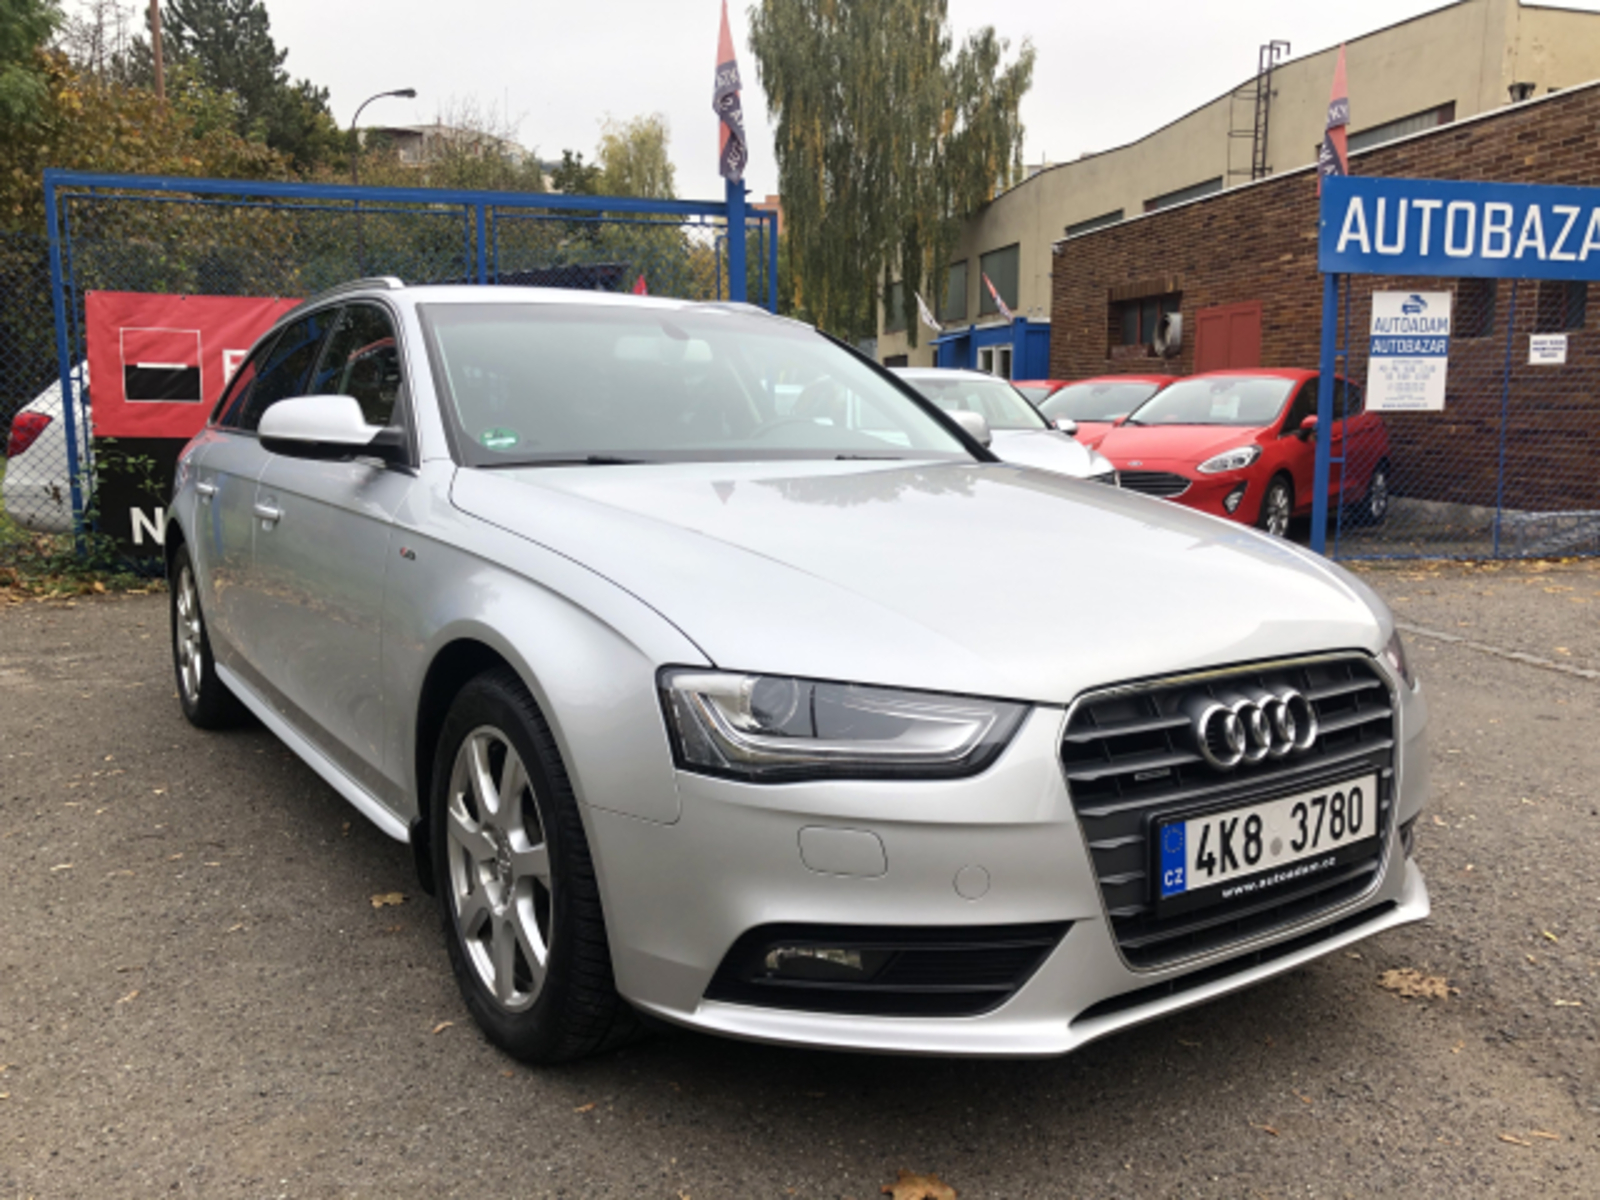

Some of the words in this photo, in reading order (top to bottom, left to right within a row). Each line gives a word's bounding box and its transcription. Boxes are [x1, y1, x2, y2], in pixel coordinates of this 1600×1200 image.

[1336, 196, 1600, 262] AUTOBAZA
[1373, 316, 1448, 333] AUTOADAM
[1372, 339, 1446, 354] AUTOBAZAR
[1195, 813, 1263, 877] 4K8
[1290, 786, 1363, 852] 3780
[1164, 867, 1183, 887] CZ
